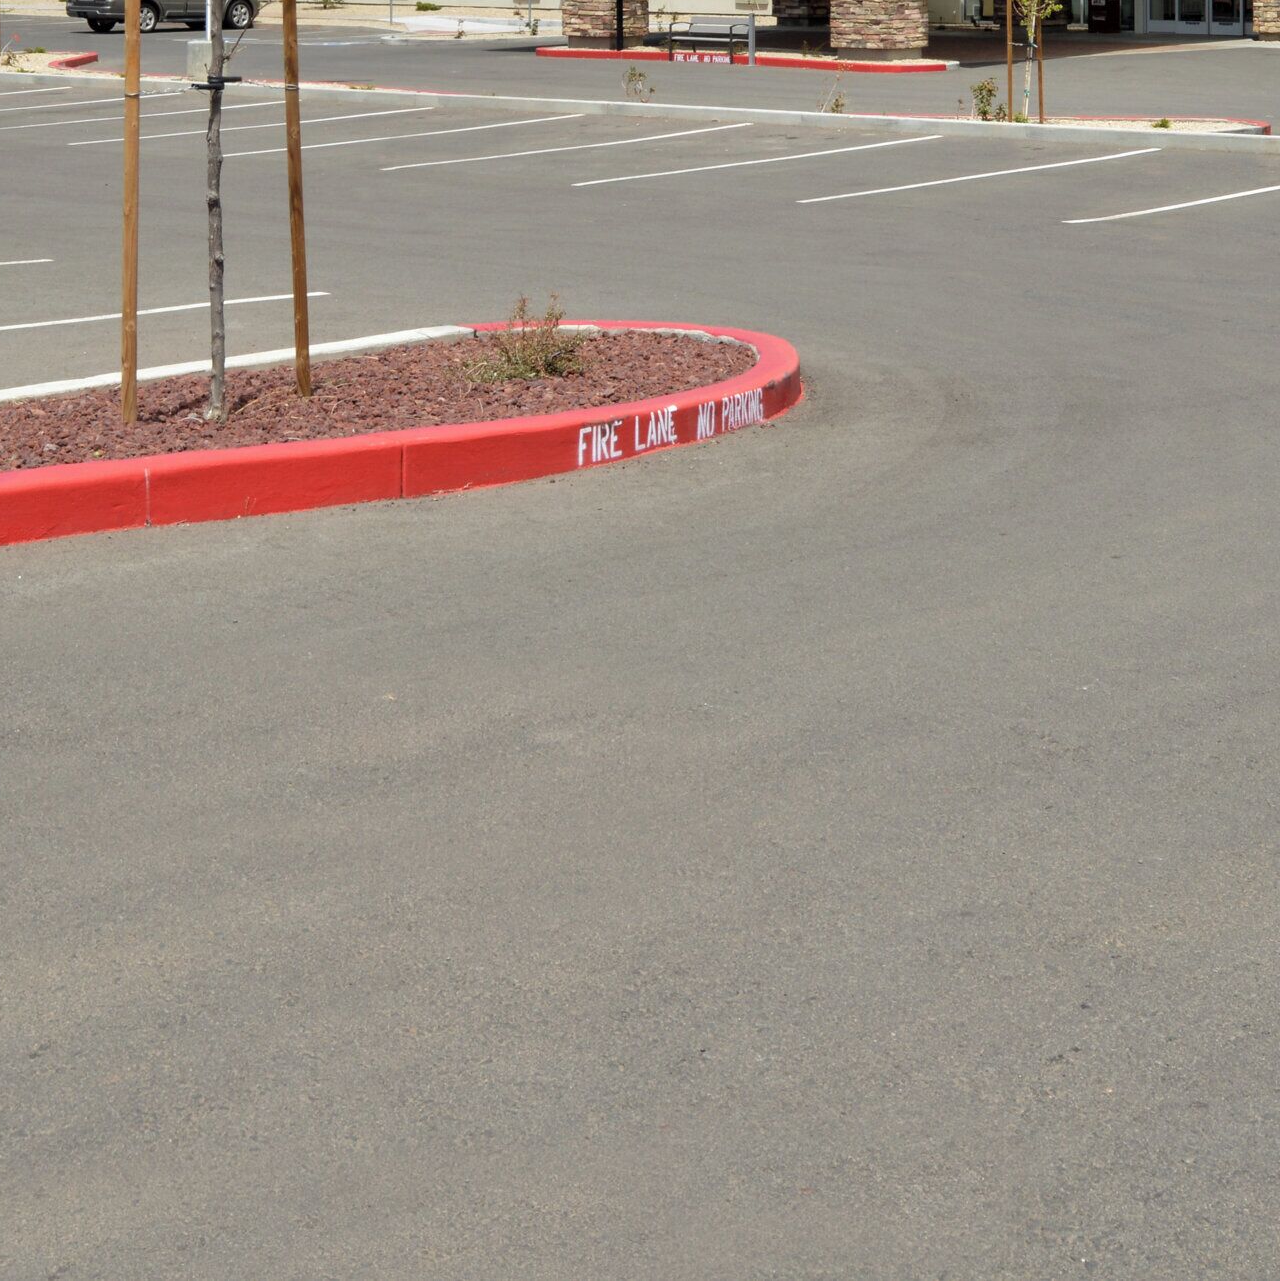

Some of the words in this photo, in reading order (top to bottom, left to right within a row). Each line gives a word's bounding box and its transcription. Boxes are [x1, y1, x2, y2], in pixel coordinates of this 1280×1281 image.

[674, 54, 684, 62] FIRE
[687, 54, 699, 63] LANE
[704, 55, 710, 63] NO
[578, 420, 622, 467] FIRE
[634, 404, 678, 451] LANE
[696, 400, 716, 441] NO
[722, 387, 764, 433] PARKING
